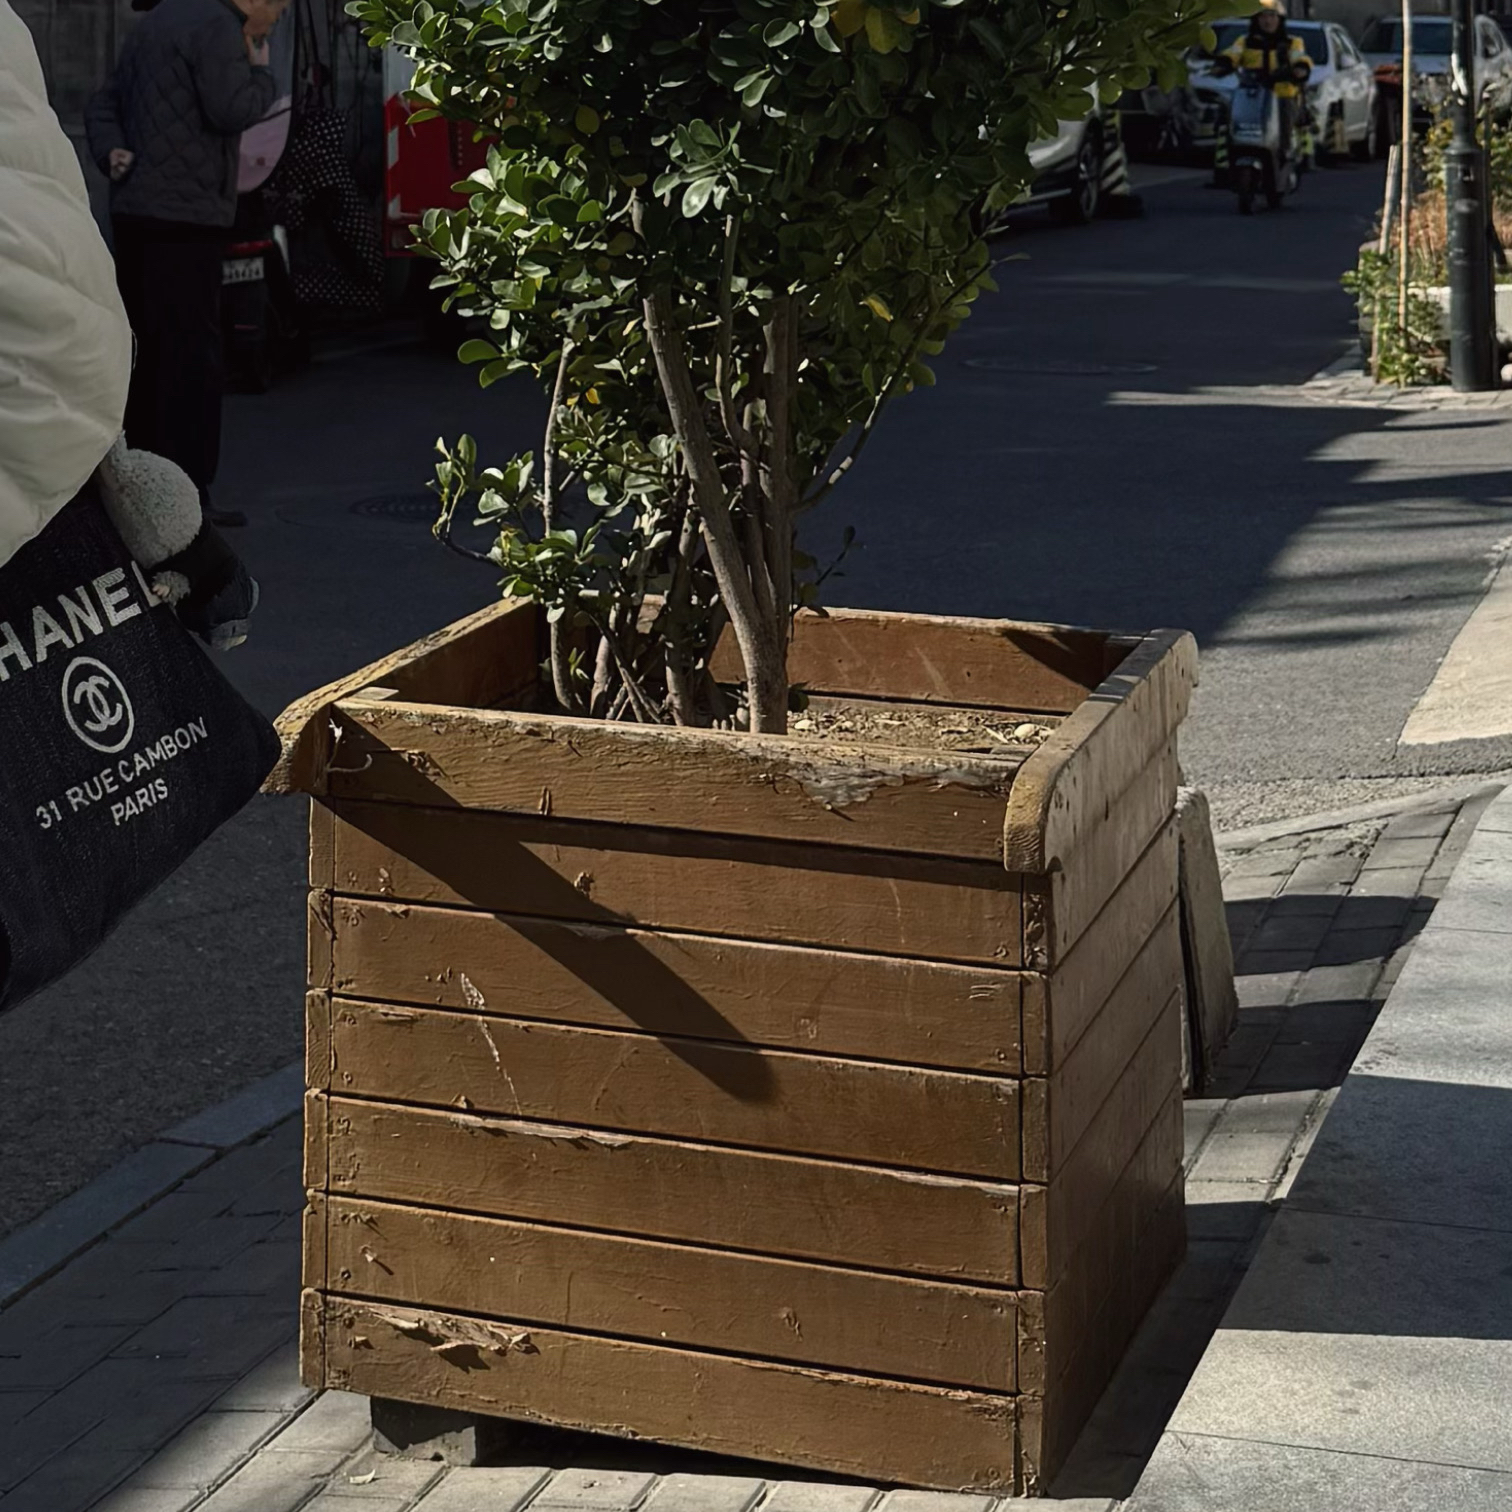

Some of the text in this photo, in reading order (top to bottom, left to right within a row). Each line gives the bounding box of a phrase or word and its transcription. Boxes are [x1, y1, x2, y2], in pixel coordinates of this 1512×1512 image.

[35, 716, 209, 830] 31 RUE CAMBON
[109, 778, 169, 827] PARIS
